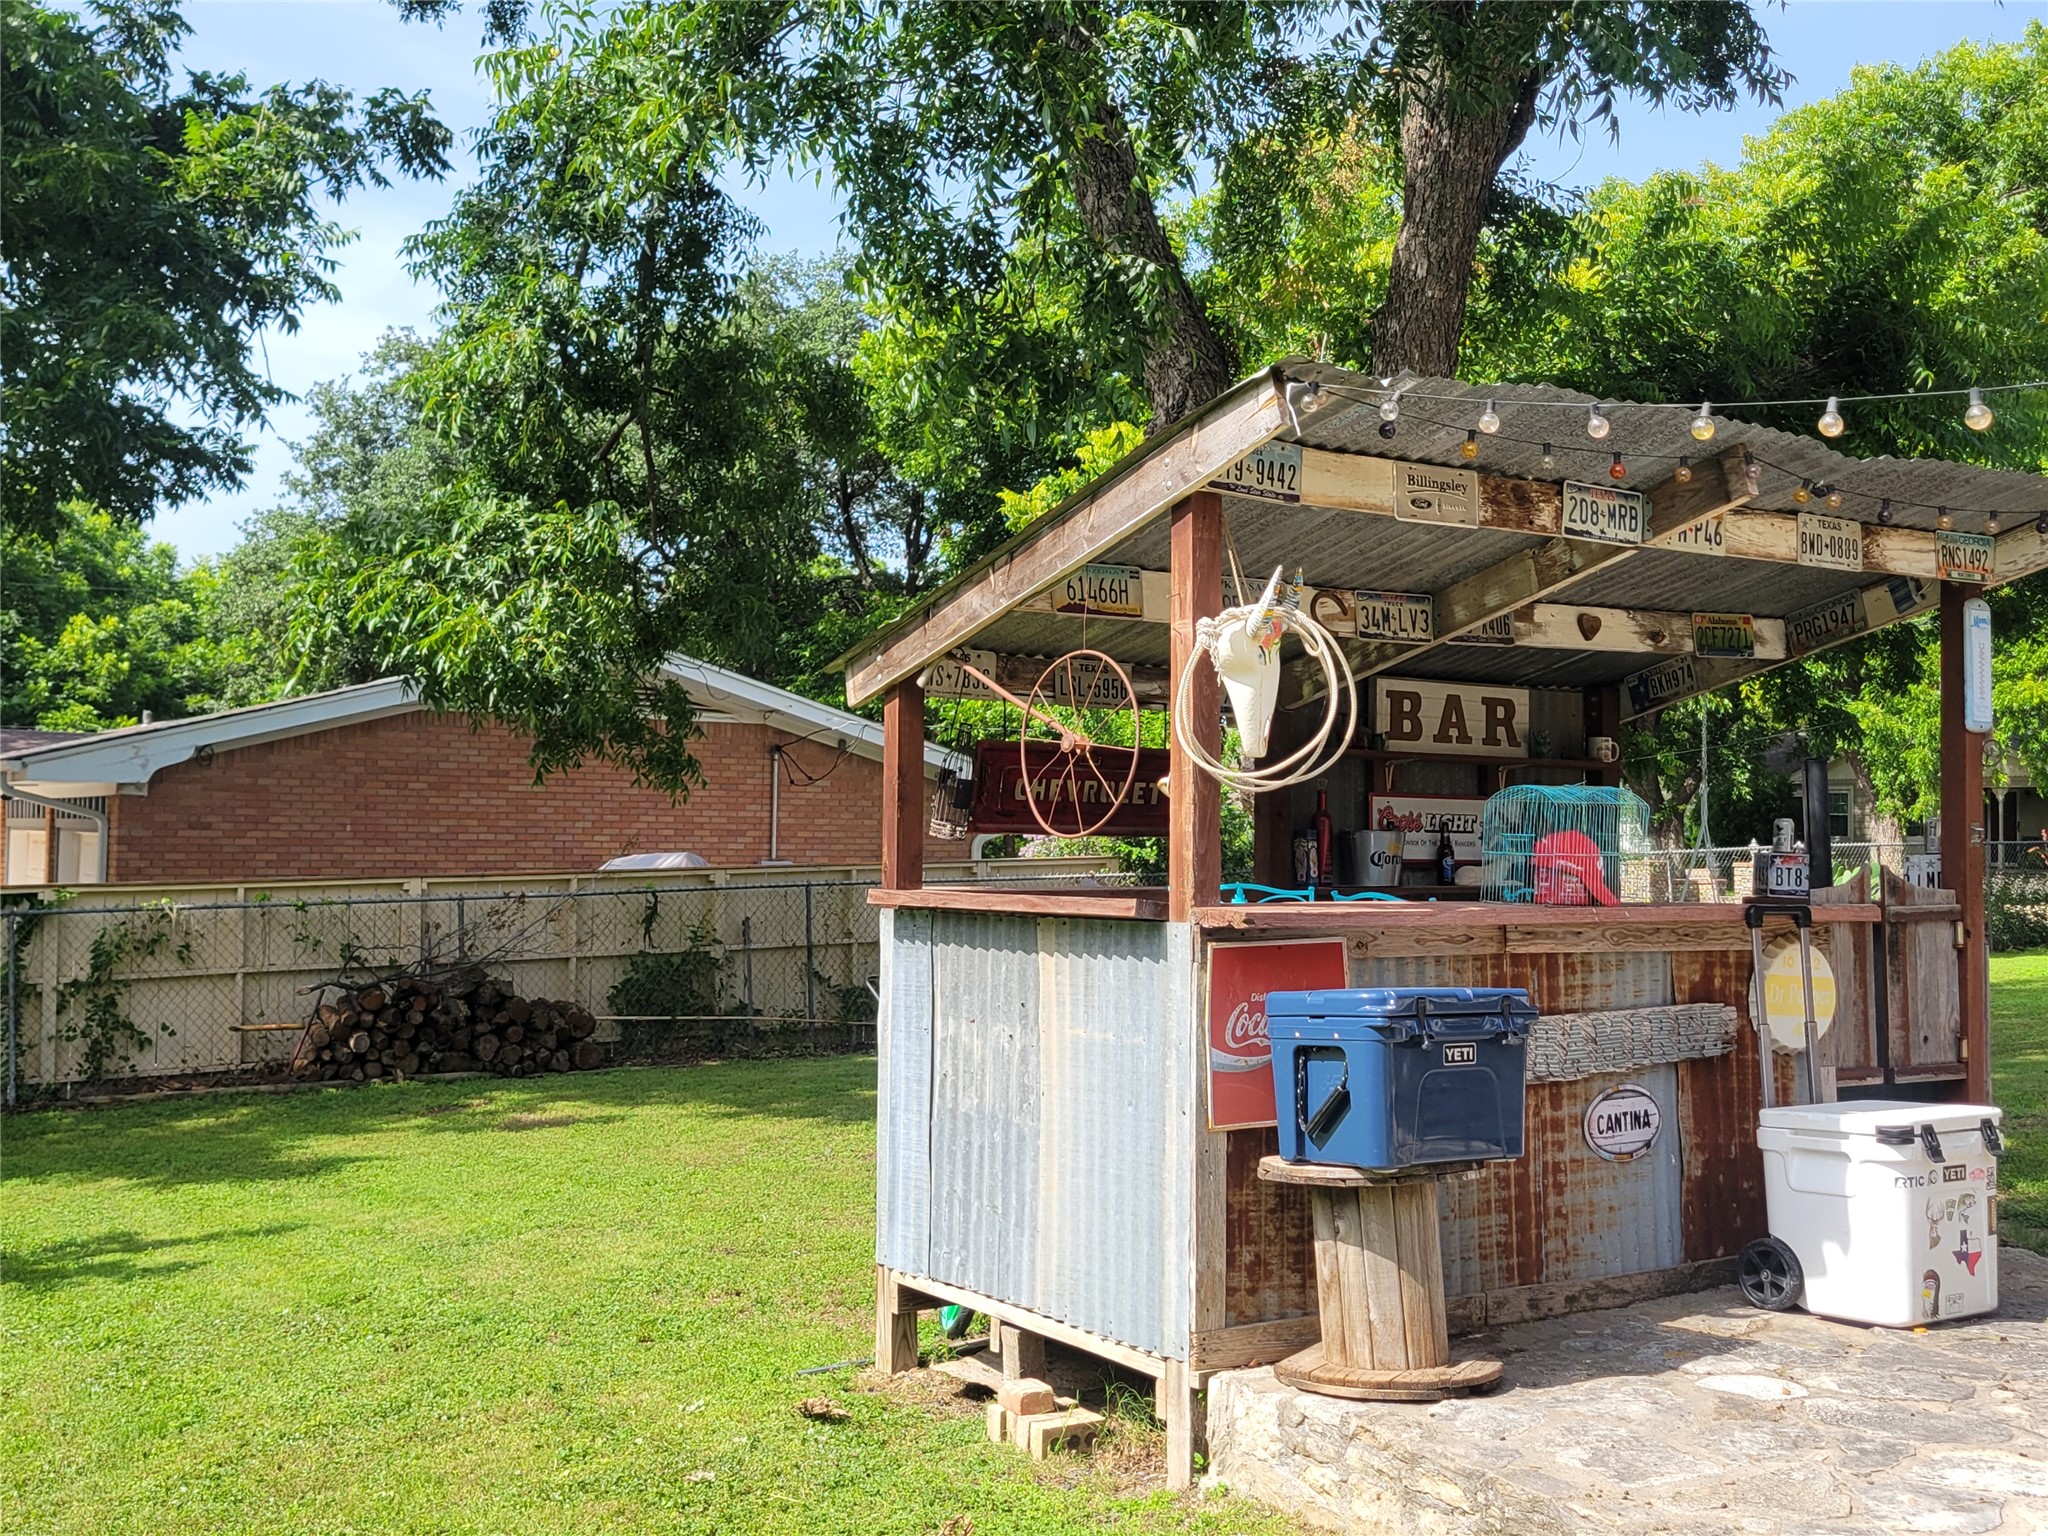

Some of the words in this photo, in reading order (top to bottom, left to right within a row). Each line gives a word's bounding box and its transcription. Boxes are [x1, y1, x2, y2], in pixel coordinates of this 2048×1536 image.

[1406, 474, 1468, 495] Billingsley
[1590, 488, 1616, 501] TEXAS
[1817, 519, 1842, 531] TEXAS
[1958, 535, 1991, 547] GEORGIA
[1941, 544, 1988, 573] RNS1492
[1066, 576, 1129, 605] 61466H
[1794, 602, 1856, 643] PRG1947
[1079, 663, 1109, 674] TEXAS
[1650, 663, 1694, 697] BKH974
[1385, 689, 1522, 748] BAR
[1014, 777, 1161, 805] CHEVROLET
[1424, 813, 1478, 834] LIGHT
[1782, 955, 1796, 969] 10
[1770, 984, 1786, 1004] Dr
[1788, 984, 1833, 1007] Peper
[1225, 1001, 1271, 1049] Coca
[1445, 1047, 1474, 1061] YETI
[1596, 1108, 1652, 1136] CANTINA
[1944, 1166, 1965, 1181] YETI
